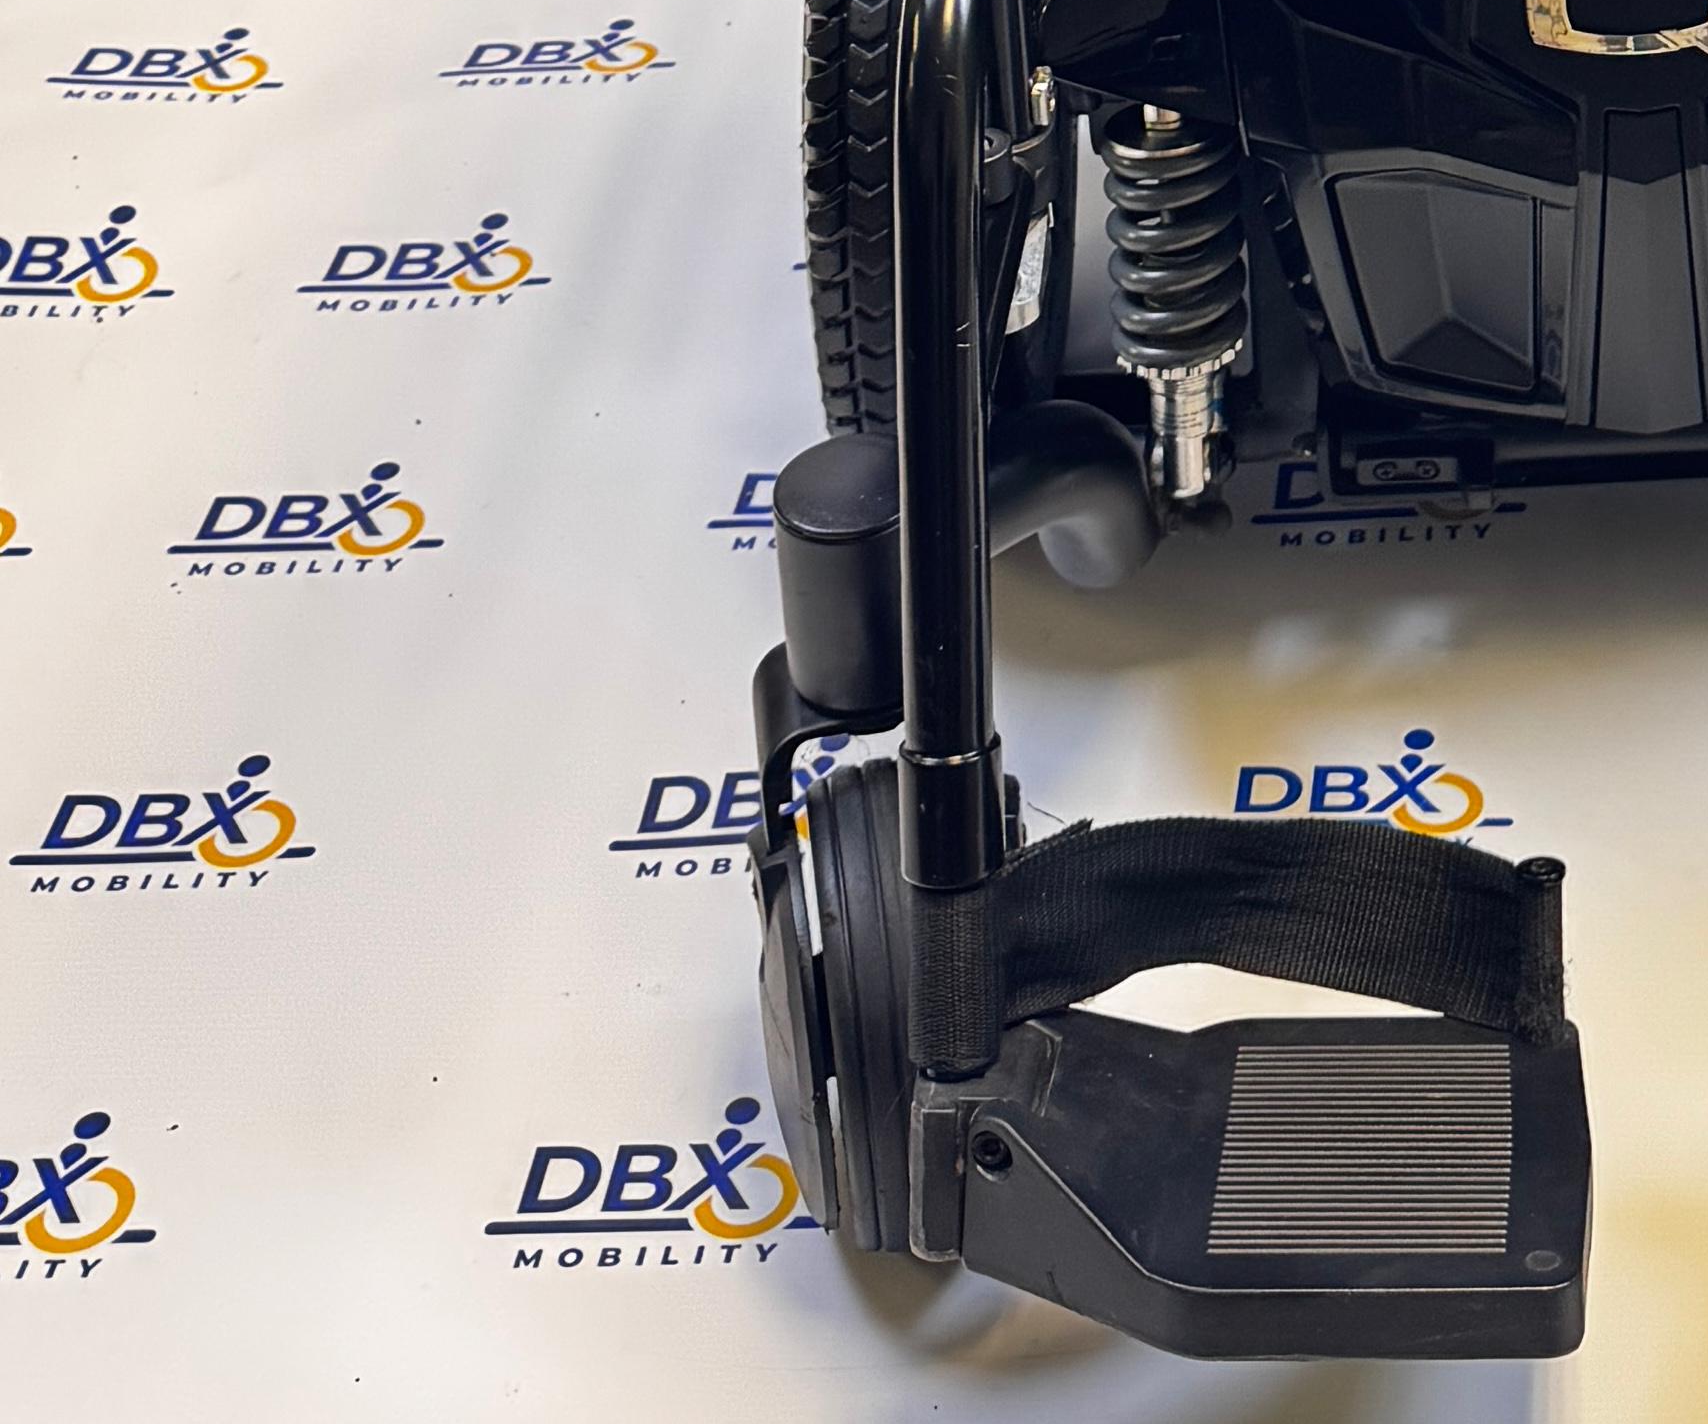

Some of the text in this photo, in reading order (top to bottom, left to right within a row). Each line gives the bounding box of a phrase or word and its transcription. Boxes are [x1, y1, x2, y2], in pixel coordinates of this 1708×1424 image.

[70, 47, 247, 80] DBX
[463, 36, 635, 69] DBX
[0, 234, 138, 285] BX
[322, 239, 510, 282] DBX
[0, 303, 137, 319] BILITY
[316, 292, 513, 312] MOBILITY
[194, 491, 401, 541] DBX
[1279, 522, 1492, 547] MOBILITY
[187, 557, 403, 577] MOBILITY
[1234, 763, 1447, 814] DBX
[40, 790, 271, 850] DBX
[30, 870, 269, 893] MOBILITY
[516, 1141, 767, 1215] DBX
[513, 1242, 779, 1269] MOBILITY
